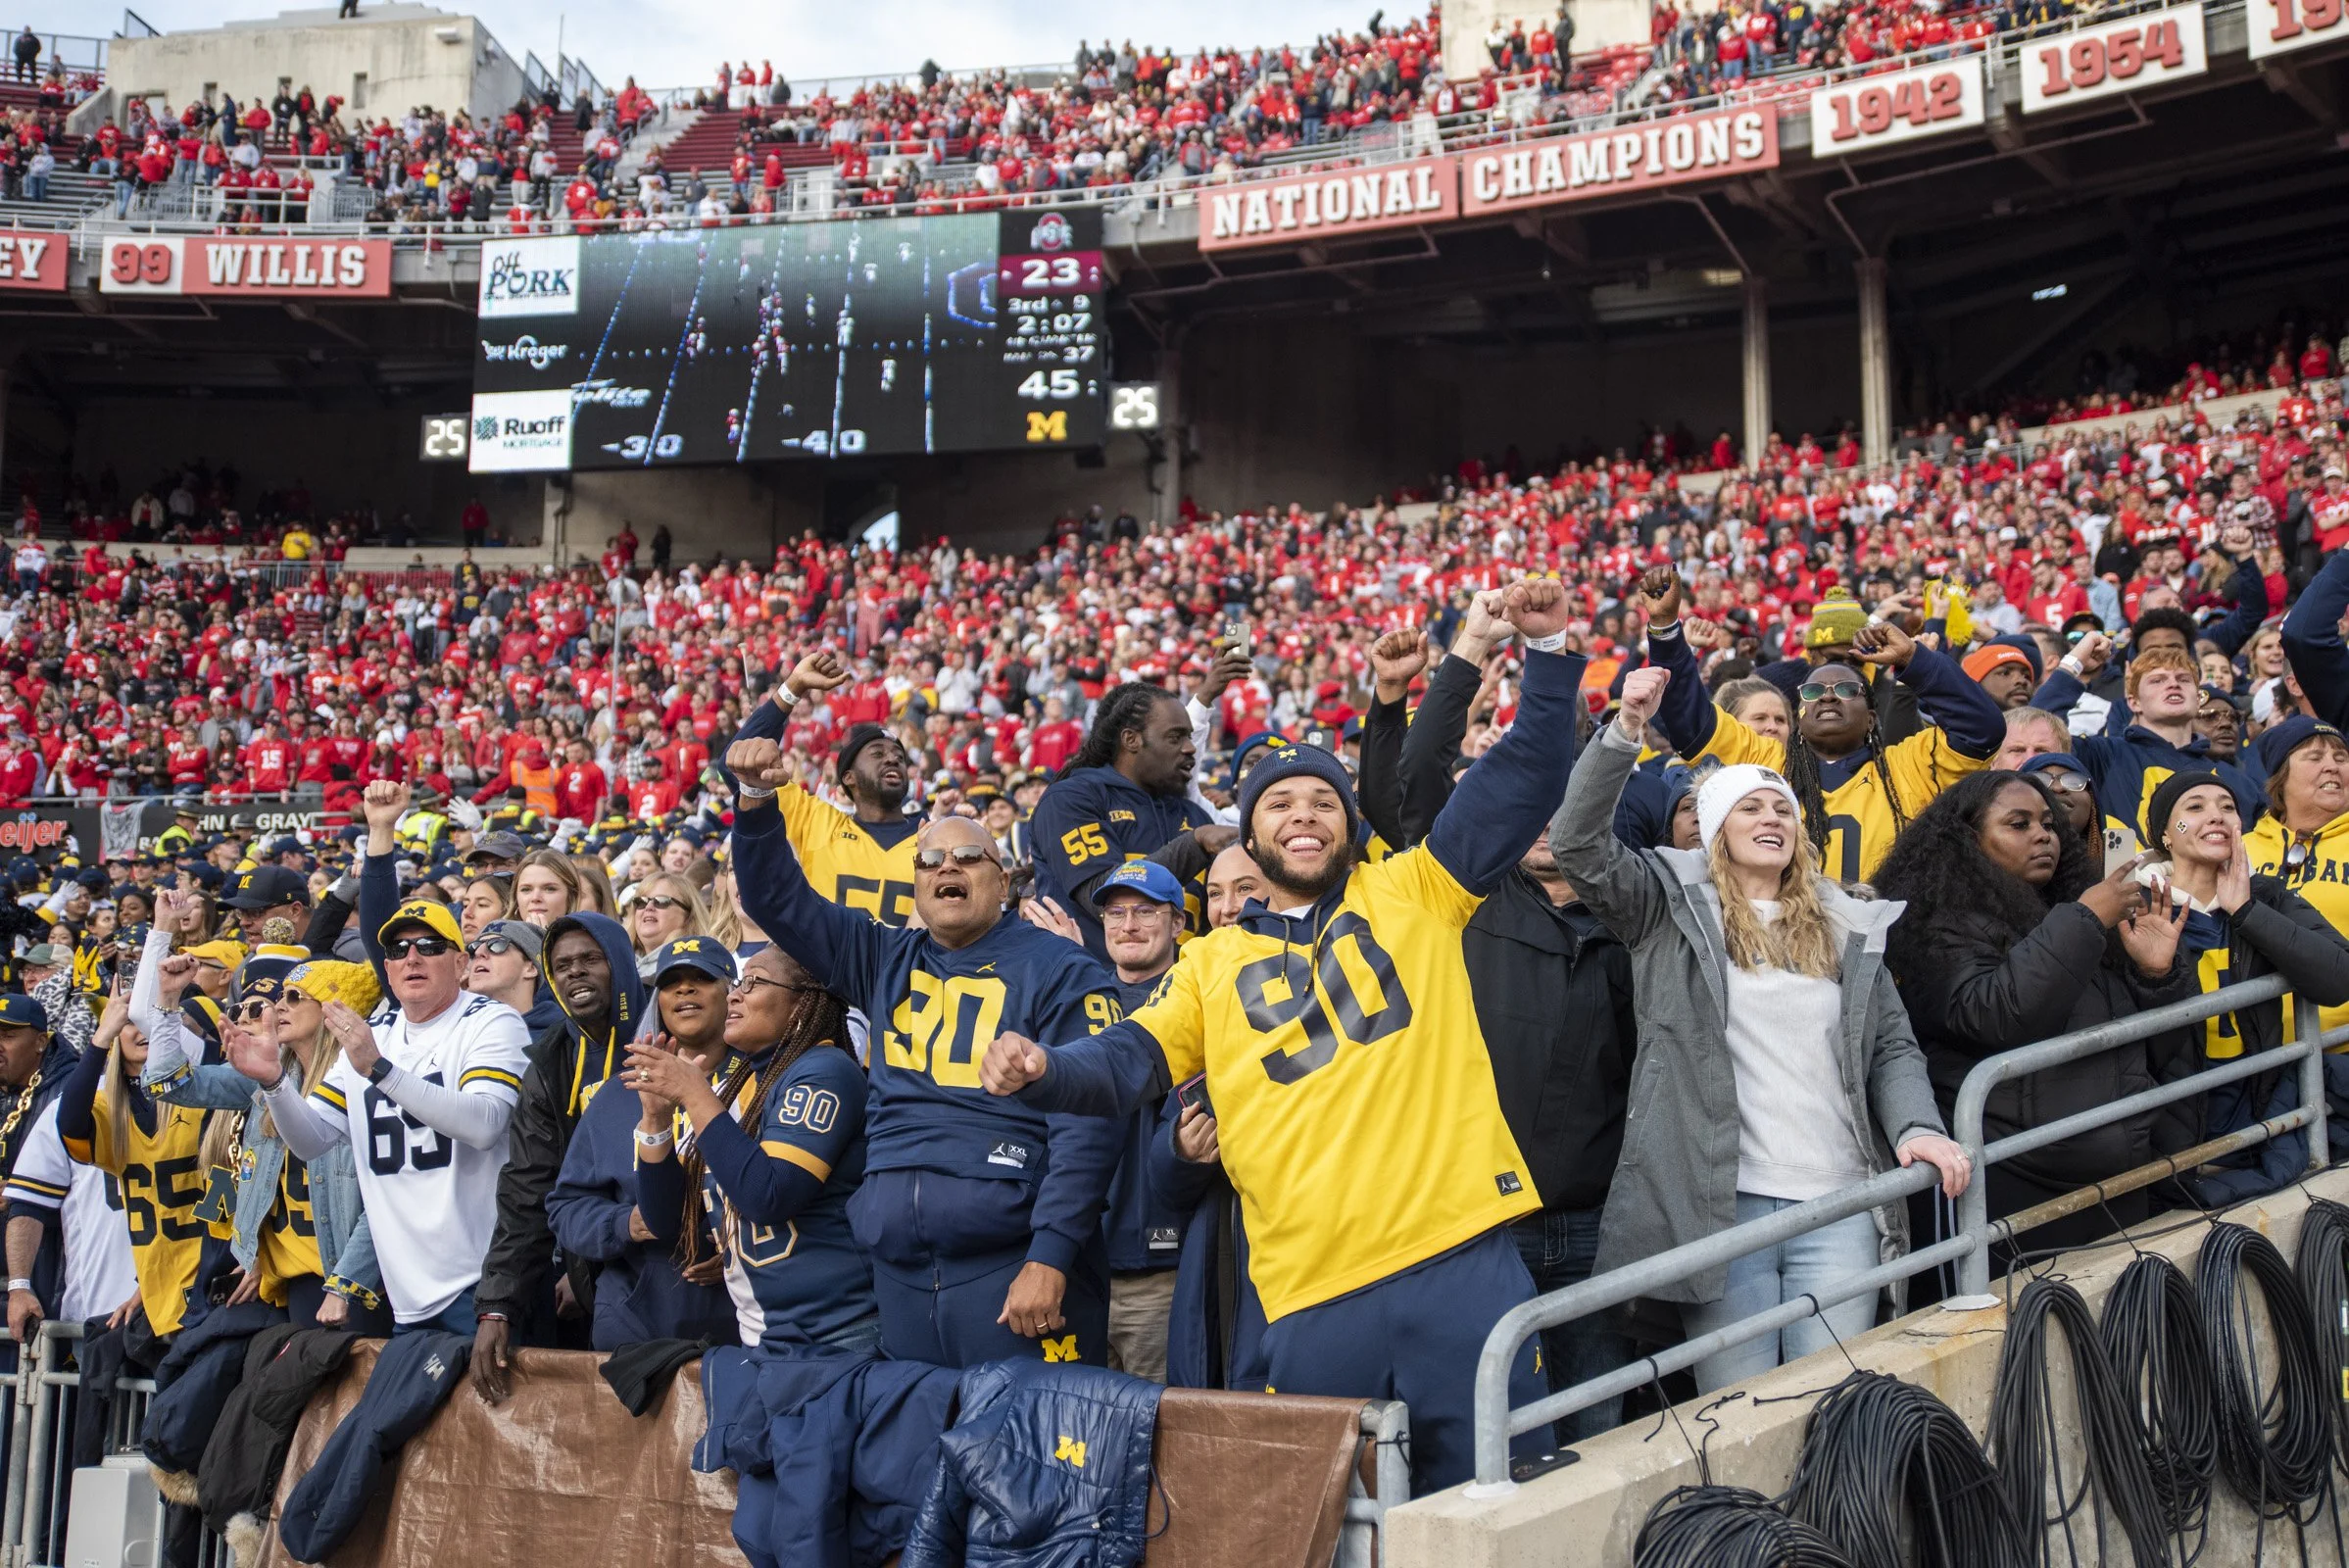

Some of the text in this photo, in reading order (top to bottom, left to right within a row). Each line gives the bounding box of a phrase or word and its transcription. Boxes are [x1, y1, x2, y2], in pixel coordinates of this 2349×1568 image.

[2270, 0, 2349, 42] 19
[2040, 19, 2183, 97] 1954
[1830, 73, 1963, 142] 1942
[1211, 111, 1764, 238] NATIONAL CHAMPIONS
[110, 242, 367, 287] 99 WILLIS
[1021, 257, 1081, 288] 23
[485, 269, 574, 295] PORK
[1007, 297, 1049, 315] 3rd
[1017, 312, 1093, 336] 2:07
[508, 334, 568, 370] Kroger
[1061, 345, 1096, 364] 37
[1018, 368, 1080, 401] 45
[1113, 386, 1158, 428] 25
[425, 418, 465, 457] 25
[504, 416, 565, 435] Ruoff
[1026, 410, 1067, 442] M
[2045, 602, 2064, 632] 5
[1815, 627, 1835, 643] M
[261, 750, 282, 770] 15
[1278, 749, 1297, 760] M
[568, 771, 582, 793] 2
[256, 812, 312, 830] GRAY
[638, 794, 657, 819] 2
[1060, 822, 1109, 866] 55
[403, 906, 427, 918] M
[671, 939, 701, 956] M
[1235, 910, 1414, 1087] 90
[619, 1011, 629, 1021] GO
[884, 968, 1007, 1089] 90
[778, 1084, 841, 1134] 90
[1010, 1146, 1027, 1157] XXL
[122, 1154, 207, 1247] 65
[1041, 1334, 1080, 1363] M
[1054, 1435, 1087, 1469] M
